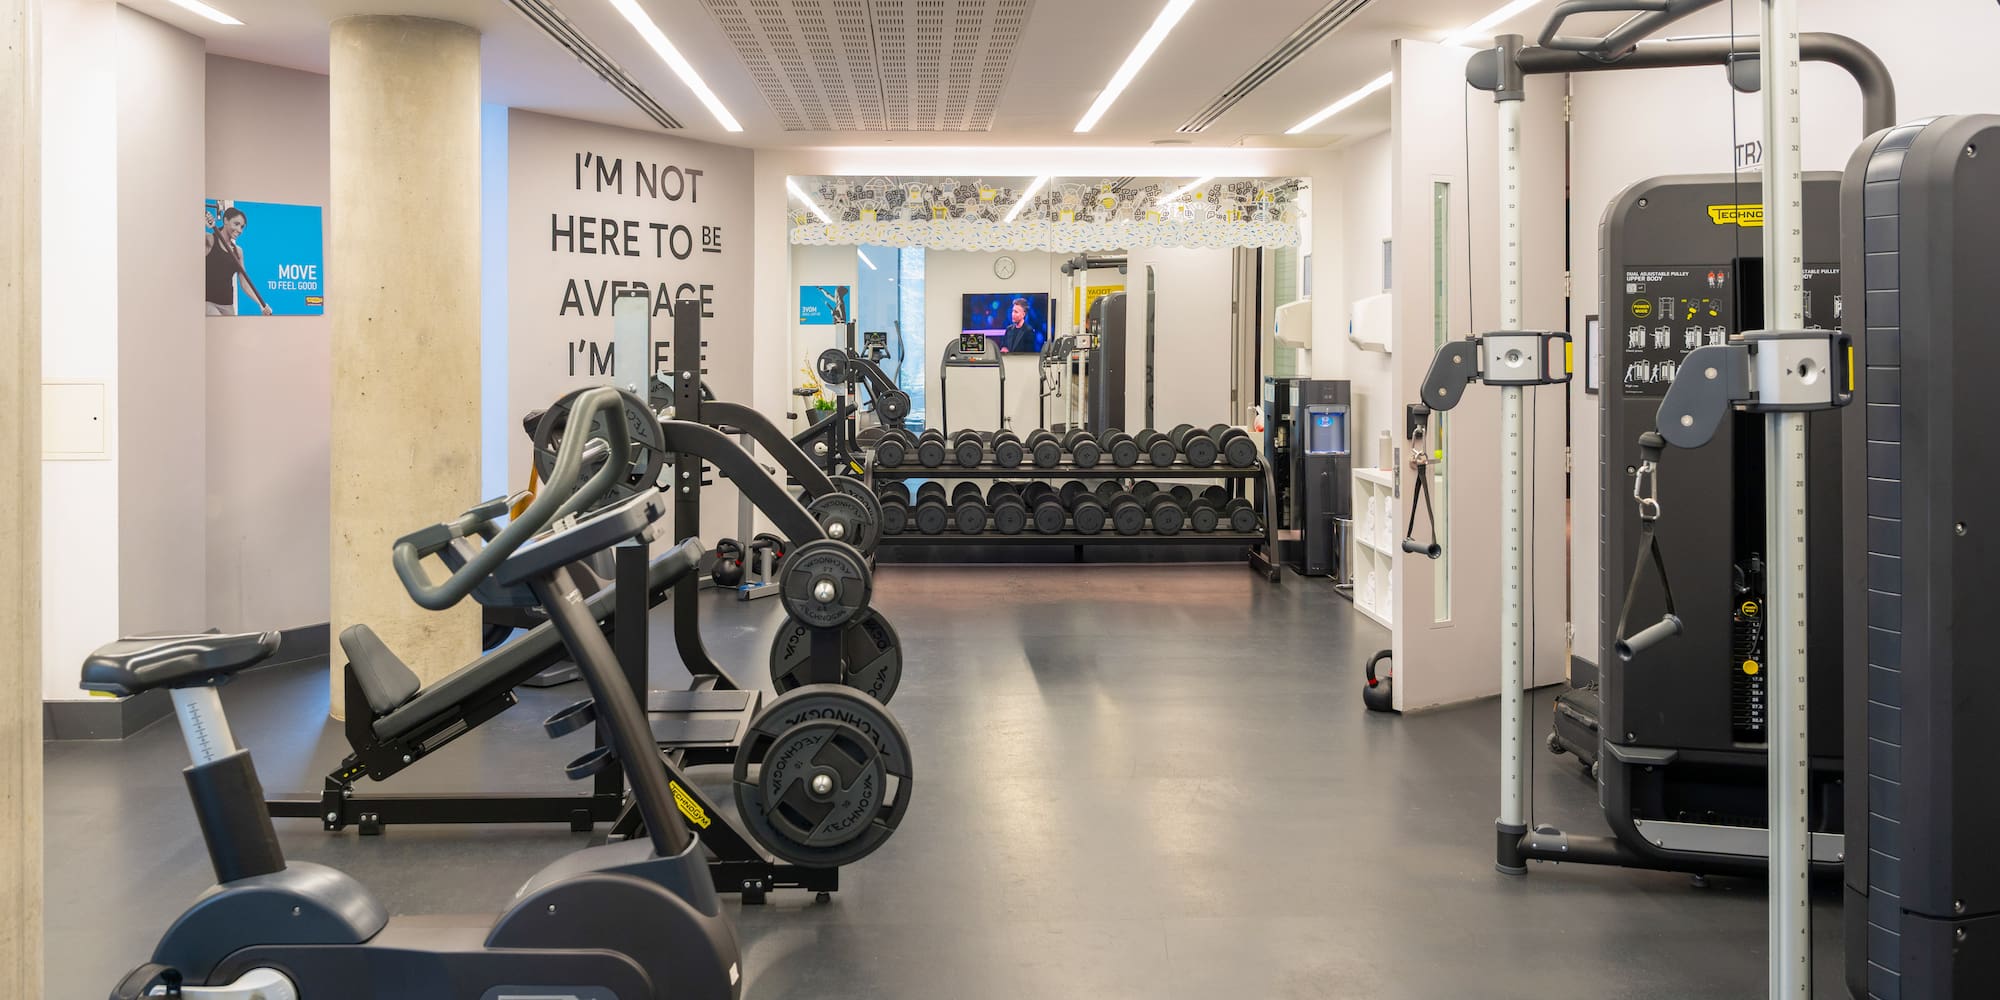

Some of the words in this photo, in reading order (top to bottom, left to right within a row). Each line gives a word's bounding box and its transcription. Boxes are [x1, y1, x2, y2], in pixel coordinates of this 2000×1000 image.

[576, 152, 622, 194] I'M
[636, 161, 703, 203] NOT
[1713, 207, 1763, 219] TECHNO
[552, 213, 640, 257] HERE
[649, 222, 693, 260] TO
[702, 226, 722, 247] BE
[267, 281, 277, 290] TO
[278, 281, 296, 290] FEEL
[297, 282, 317, 290] GOOD
[278, 264, 317, 280] MOVE
[560, 279, 714, 318] AVEAE
[569, 339, 615, 376] I'M
[785, 708, 890, 757] TECHNOGYM
[773, 735, 823, 795] TECHNOGYM
[671, 785, 709, 827] TECHNOGYM
[822, 774, 873, 834] TECHNOGYM
